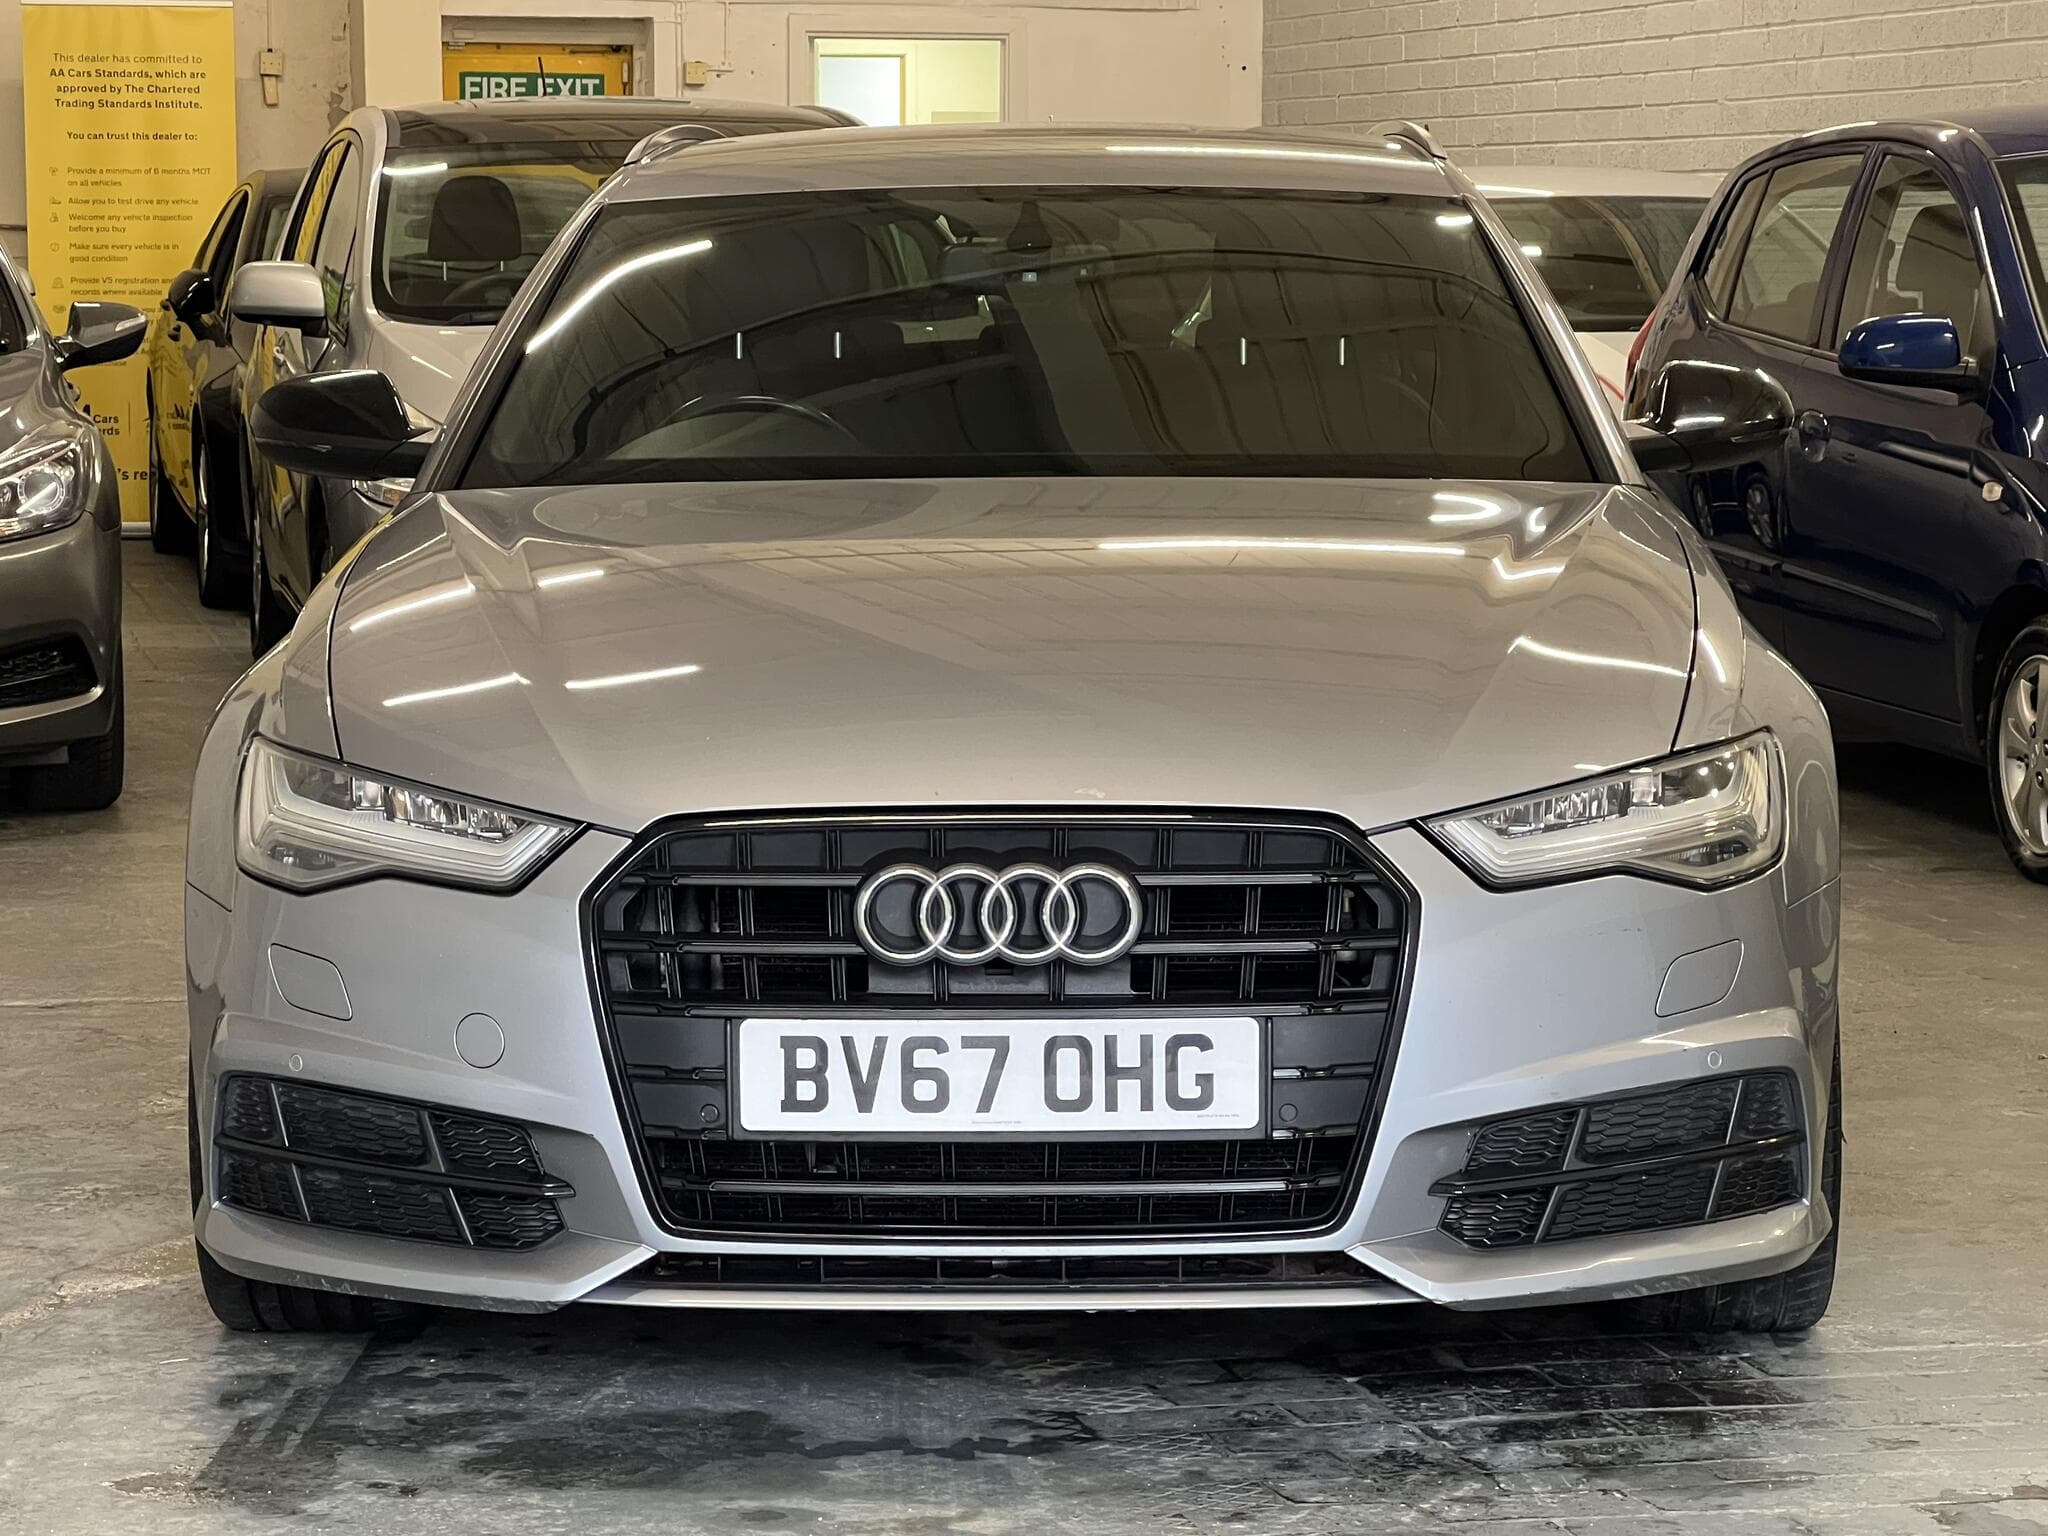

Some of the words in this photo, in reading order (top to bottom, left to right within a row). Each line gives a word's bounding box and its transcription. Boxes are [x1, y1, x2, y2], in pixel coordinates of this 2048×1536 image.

[54, 53, 74, 62] This
[77, 54, 109, 62] dealer
[112, 54, 130, 63] has
[133, 55, 188, 63] committed
[192, 55, 202, 63] to
[50, 68, 65, 77] AA
[68, 69, 92, 77] Cars
[95, 69, 152, 79] Standards,
[155, 70, 187, 78] which
[56, 84, 106, 93] approved
[110, 84, 121, 95] by
[125, 84, 144, 93] The
[147, 84, 200, 94] Chartered
[464, 76, 527, 100] FIRE
[537, 78, 600, 97] EXIT
[54, 98, 94, 109] Trading
[98, 99, 152, 108] Standards
[155, 100, 203, 109] Institute.
[67, 131, 84, 140] You
[107, 132, 129, 140] trust
[132, 132, 150, 140] this
[152, 132, 182, 140] dealer
[185, 133, 198, 141] to:
[67, 167, 97, 175] Provide
[144, 167, 152, 175] of
[161, 167, 190, 175] months
[80, 179, 89, 187] all
[68, 197, 90, 205] Allow
[68, 213, 105, 221] Welcome
[152, 214, 193, 223] inspection
[68, 225, 94, 233] before
[112, 226, 126, 234] buy
[69, 242, 90, 250] Make
[111, 244, 133, 252] every
[134, 243, 161, 251] vehicle
[69, 255, 90, 263] good
[70, 276, 99, 284] Provide
[102, 276, 113, 284] V5
[115, 276, 160, 285] registration
[128, 288, 162, 296] available
[93, 414, 119, 424] Cars
[779, 1035, 1010, 1114] BV67
[1043, 1034, 1215, 1113] OHG
